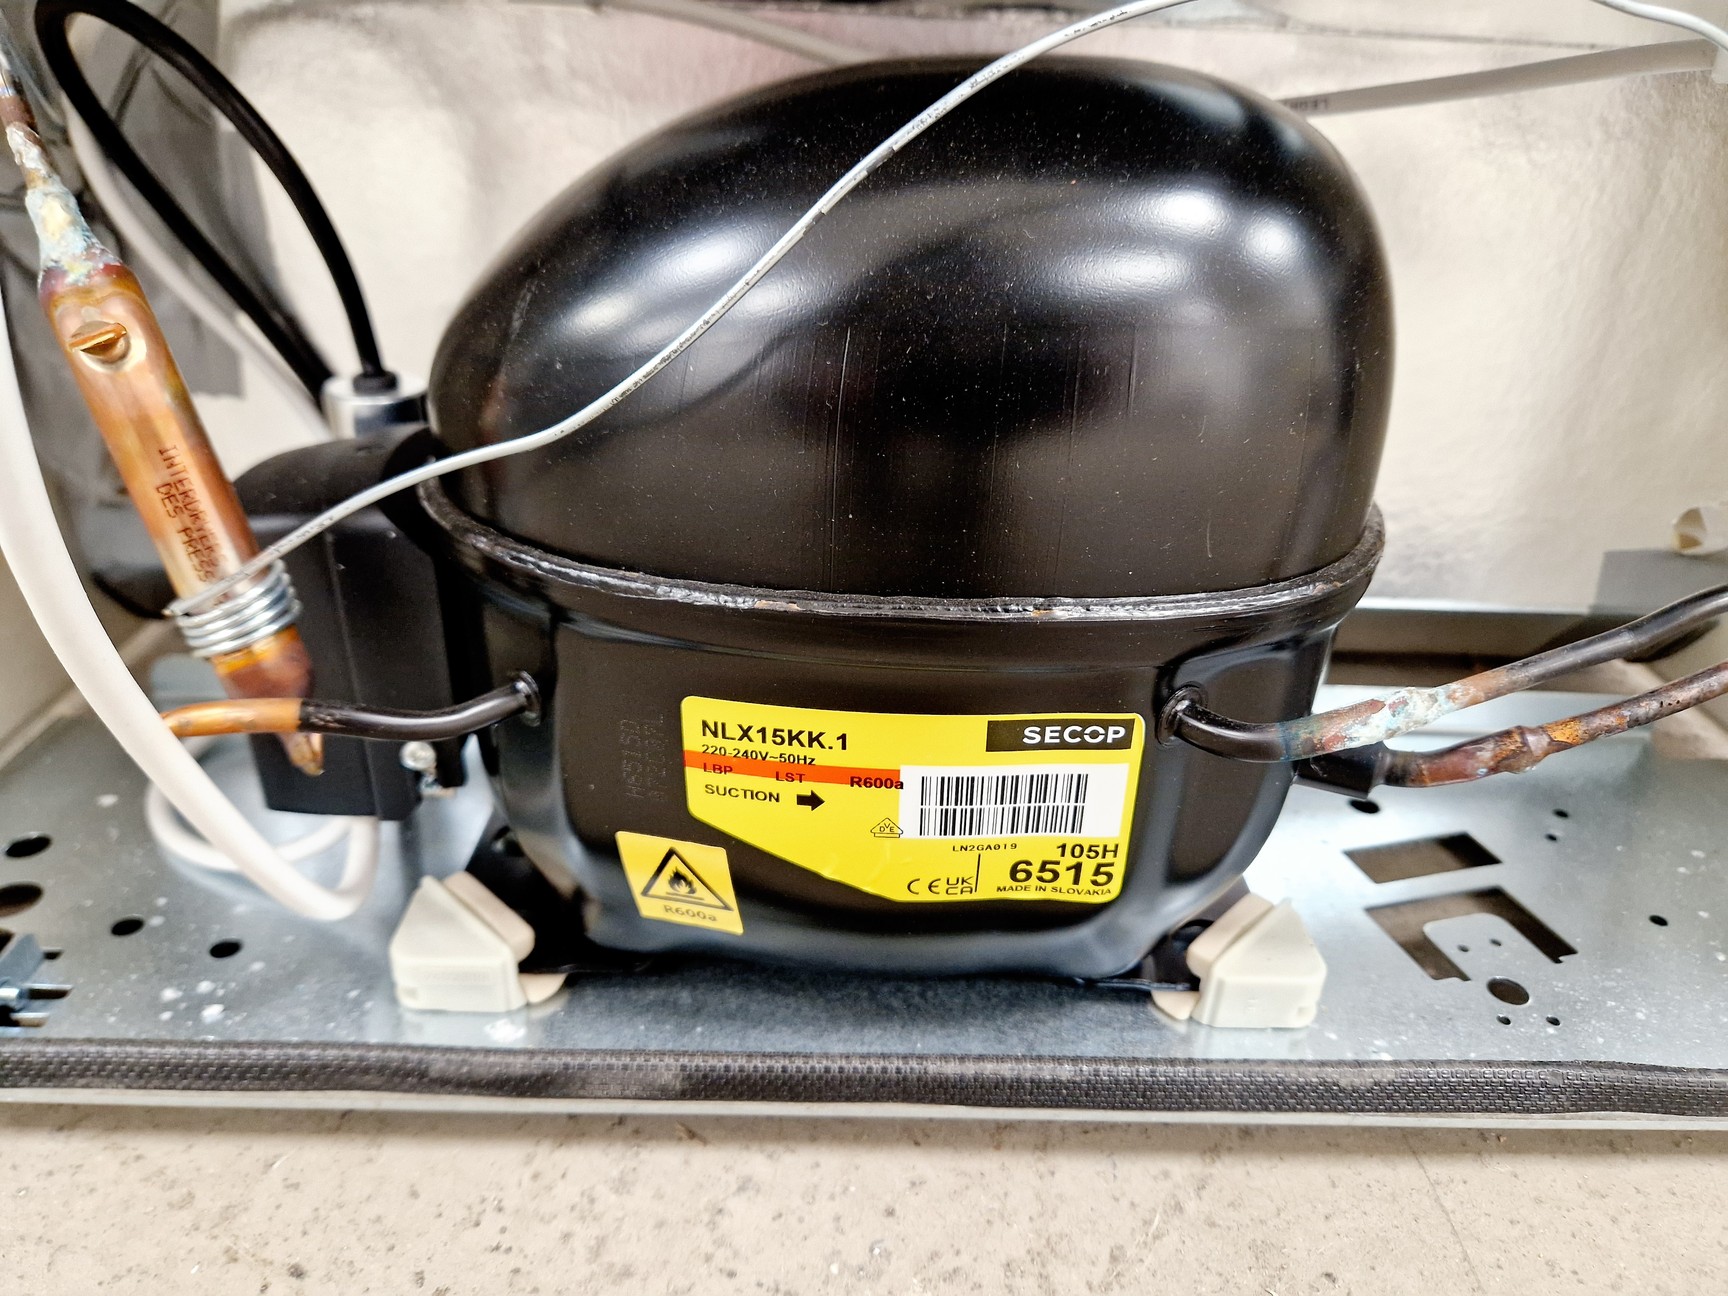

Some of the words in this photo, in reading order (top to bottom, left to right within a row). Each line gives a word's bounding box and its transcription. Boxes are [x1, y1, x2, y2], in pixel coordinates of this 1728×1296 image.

[701, 719, 848, 751] NLX15KK.1
[1022, 725, 1126, 744] SECOP
[701, 744, 816, 766] 220-240V~50Hz
[703, 762, 733, 775] LBP
[775, 771, 806, 783] LST
[849, 776, 904, 790] R600a
[704, 784, 780, 803] SUCTION
[1056, 843, 1119, 859] 105H
[1009, 859, 1115, 887] 6515
[1050, 886, 1112, 896] SLOVAKIA
[663, 904, 717, 922] R600a
